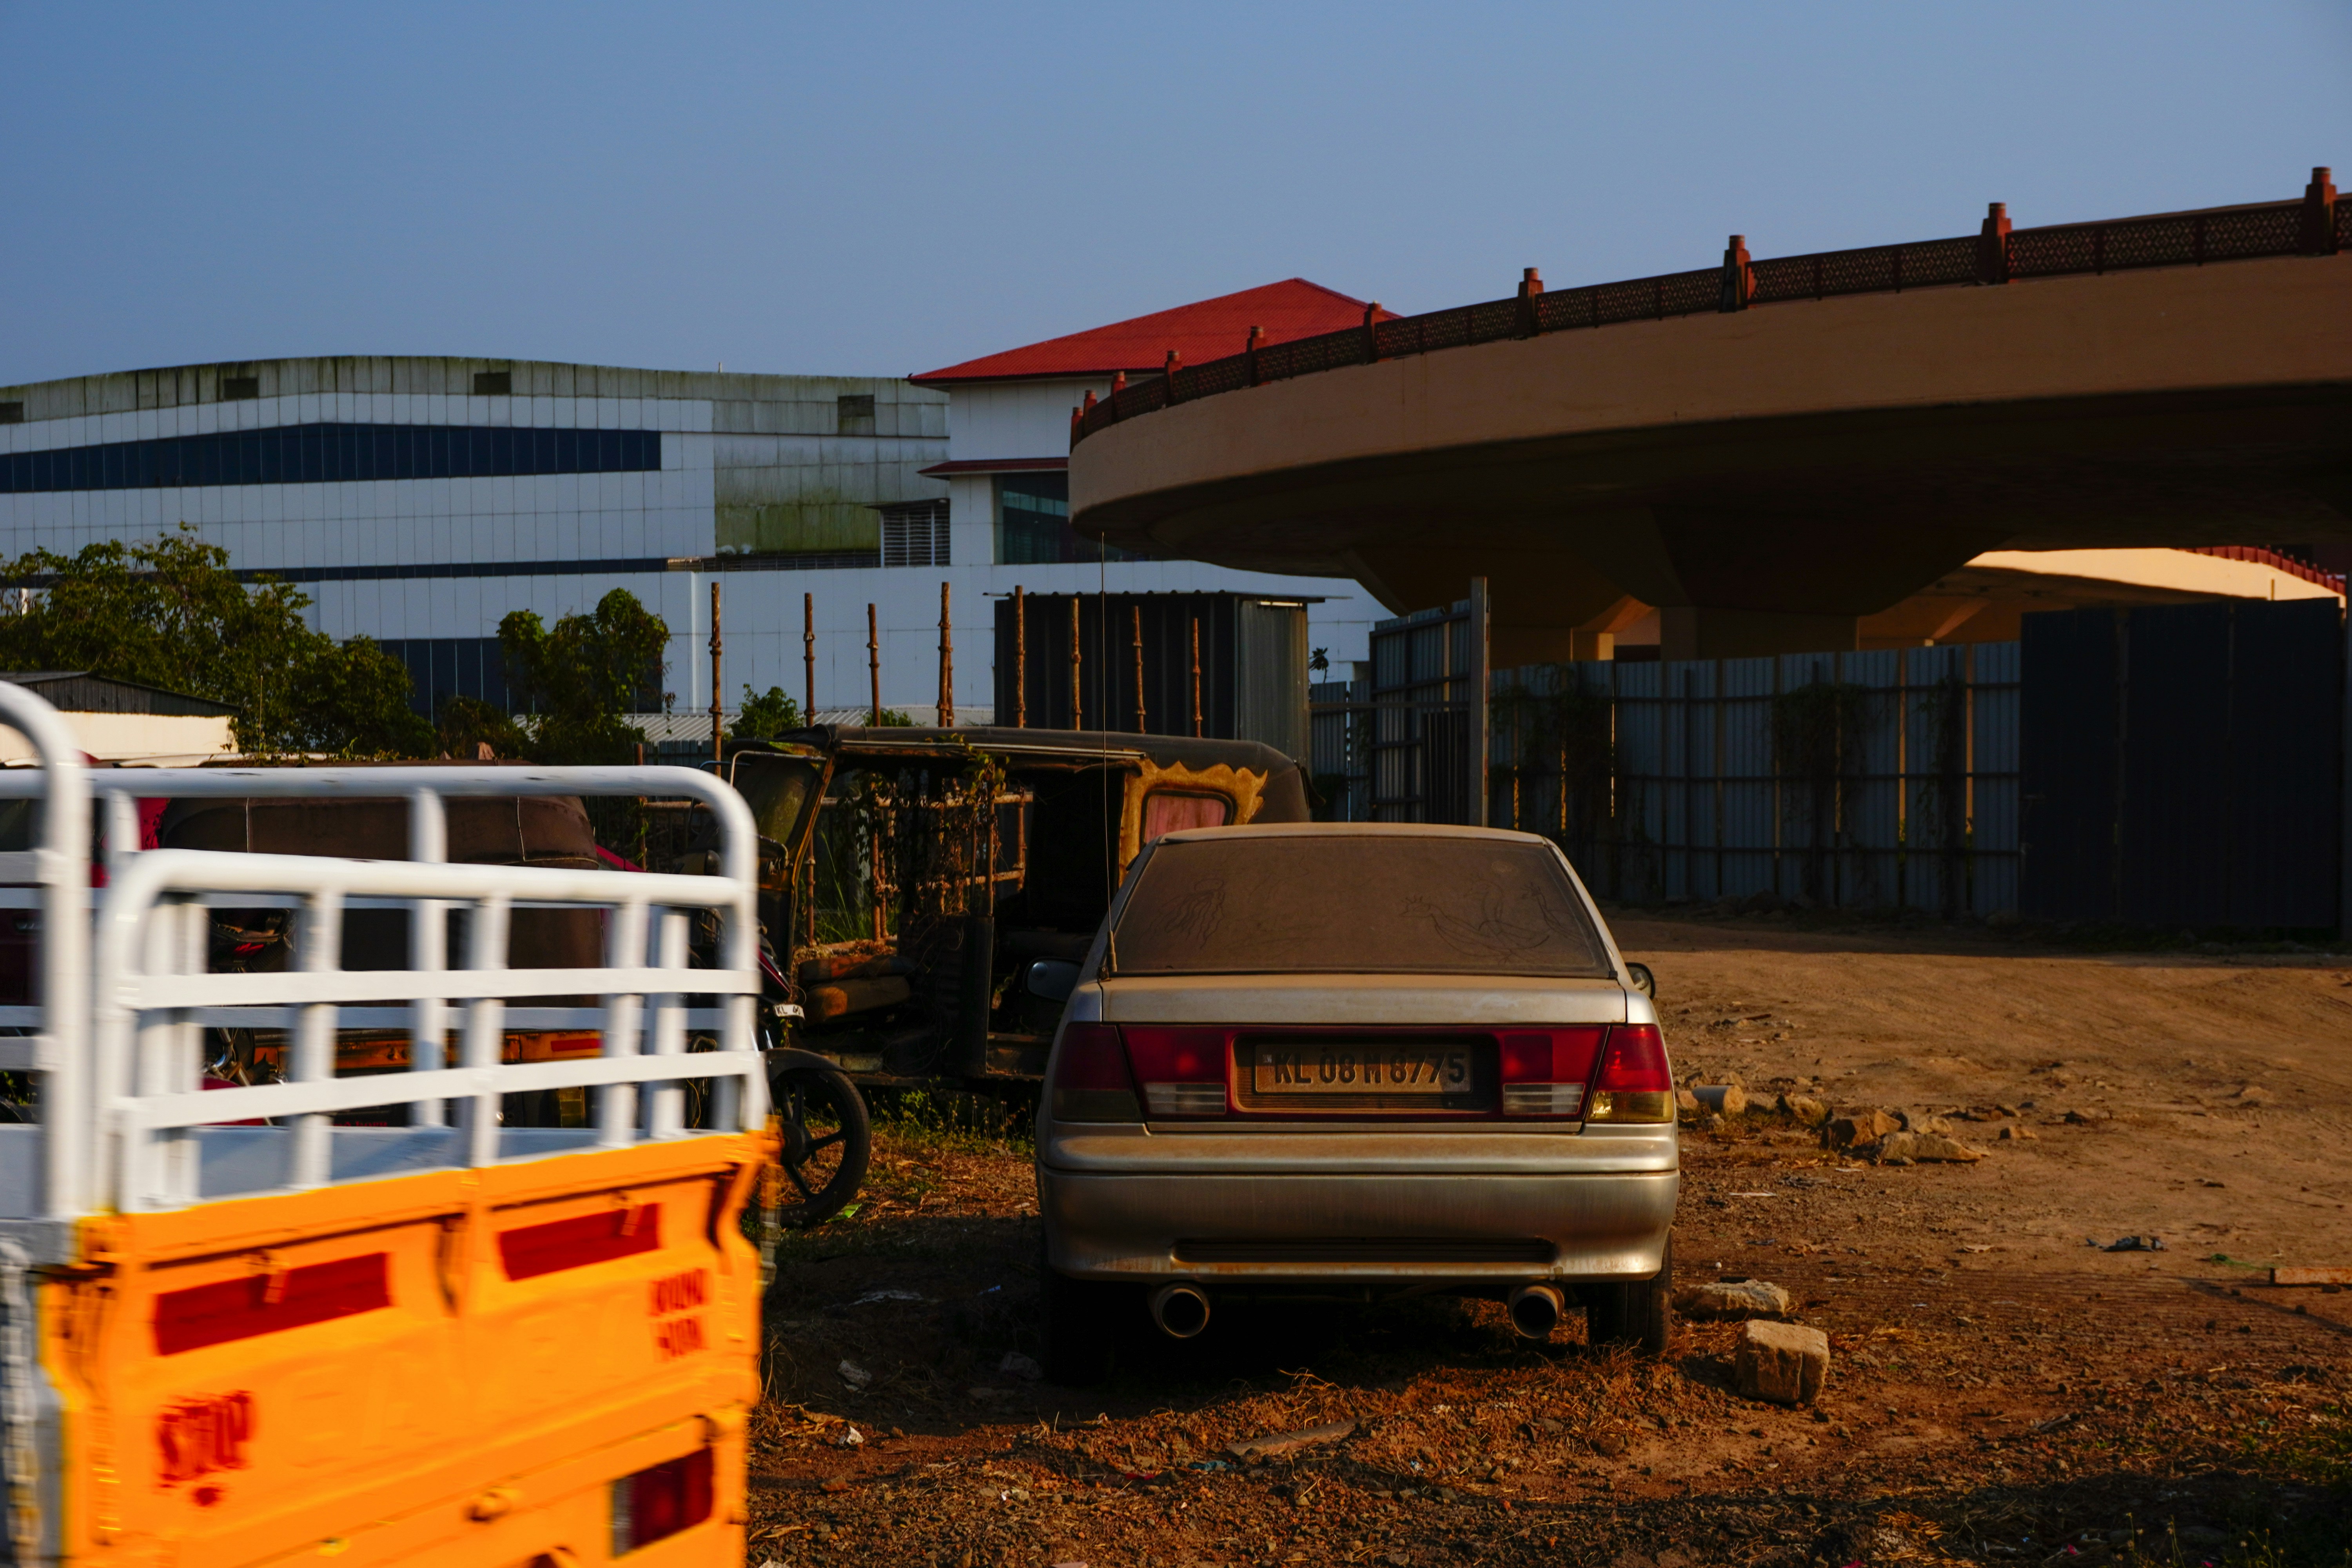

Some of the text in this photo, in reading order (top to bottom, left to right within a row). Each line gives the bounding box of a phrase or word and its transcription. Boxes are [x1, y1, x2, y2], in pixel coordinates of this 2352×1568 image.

[776, 1006, 788, 1014] KL
[1275, 1053, 1465, 1084] KL 08 M 8775
